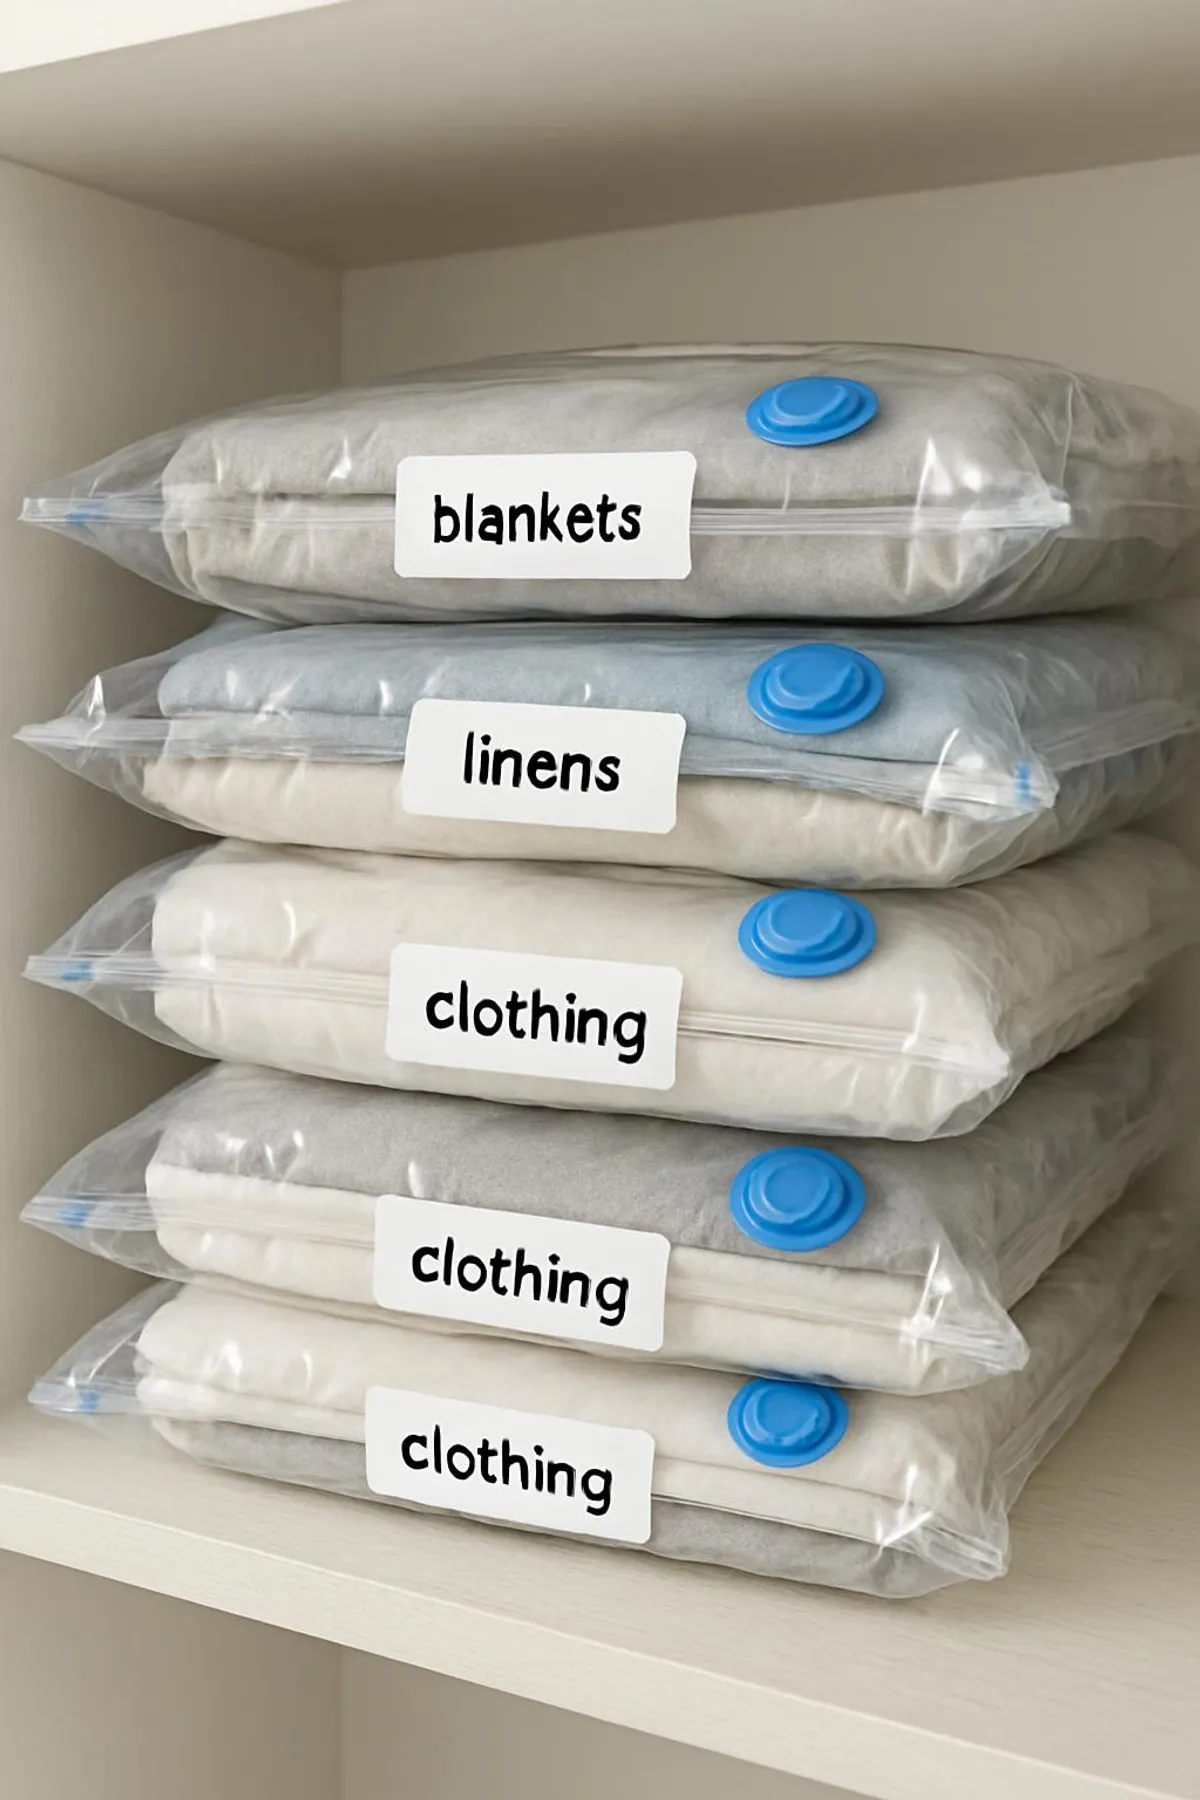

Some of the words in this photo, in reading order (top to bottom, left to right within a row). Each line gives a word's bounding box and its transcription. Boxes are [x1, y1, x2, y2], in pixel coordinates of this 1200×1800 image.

[433, 491, 642, 545] blankets
[463, 731, 621, 793] linens
[425, 980, 647, 1065] clothing
[412, 1236, 629, 1327] clothing
[401, 1424, 613, 1516] clothing
